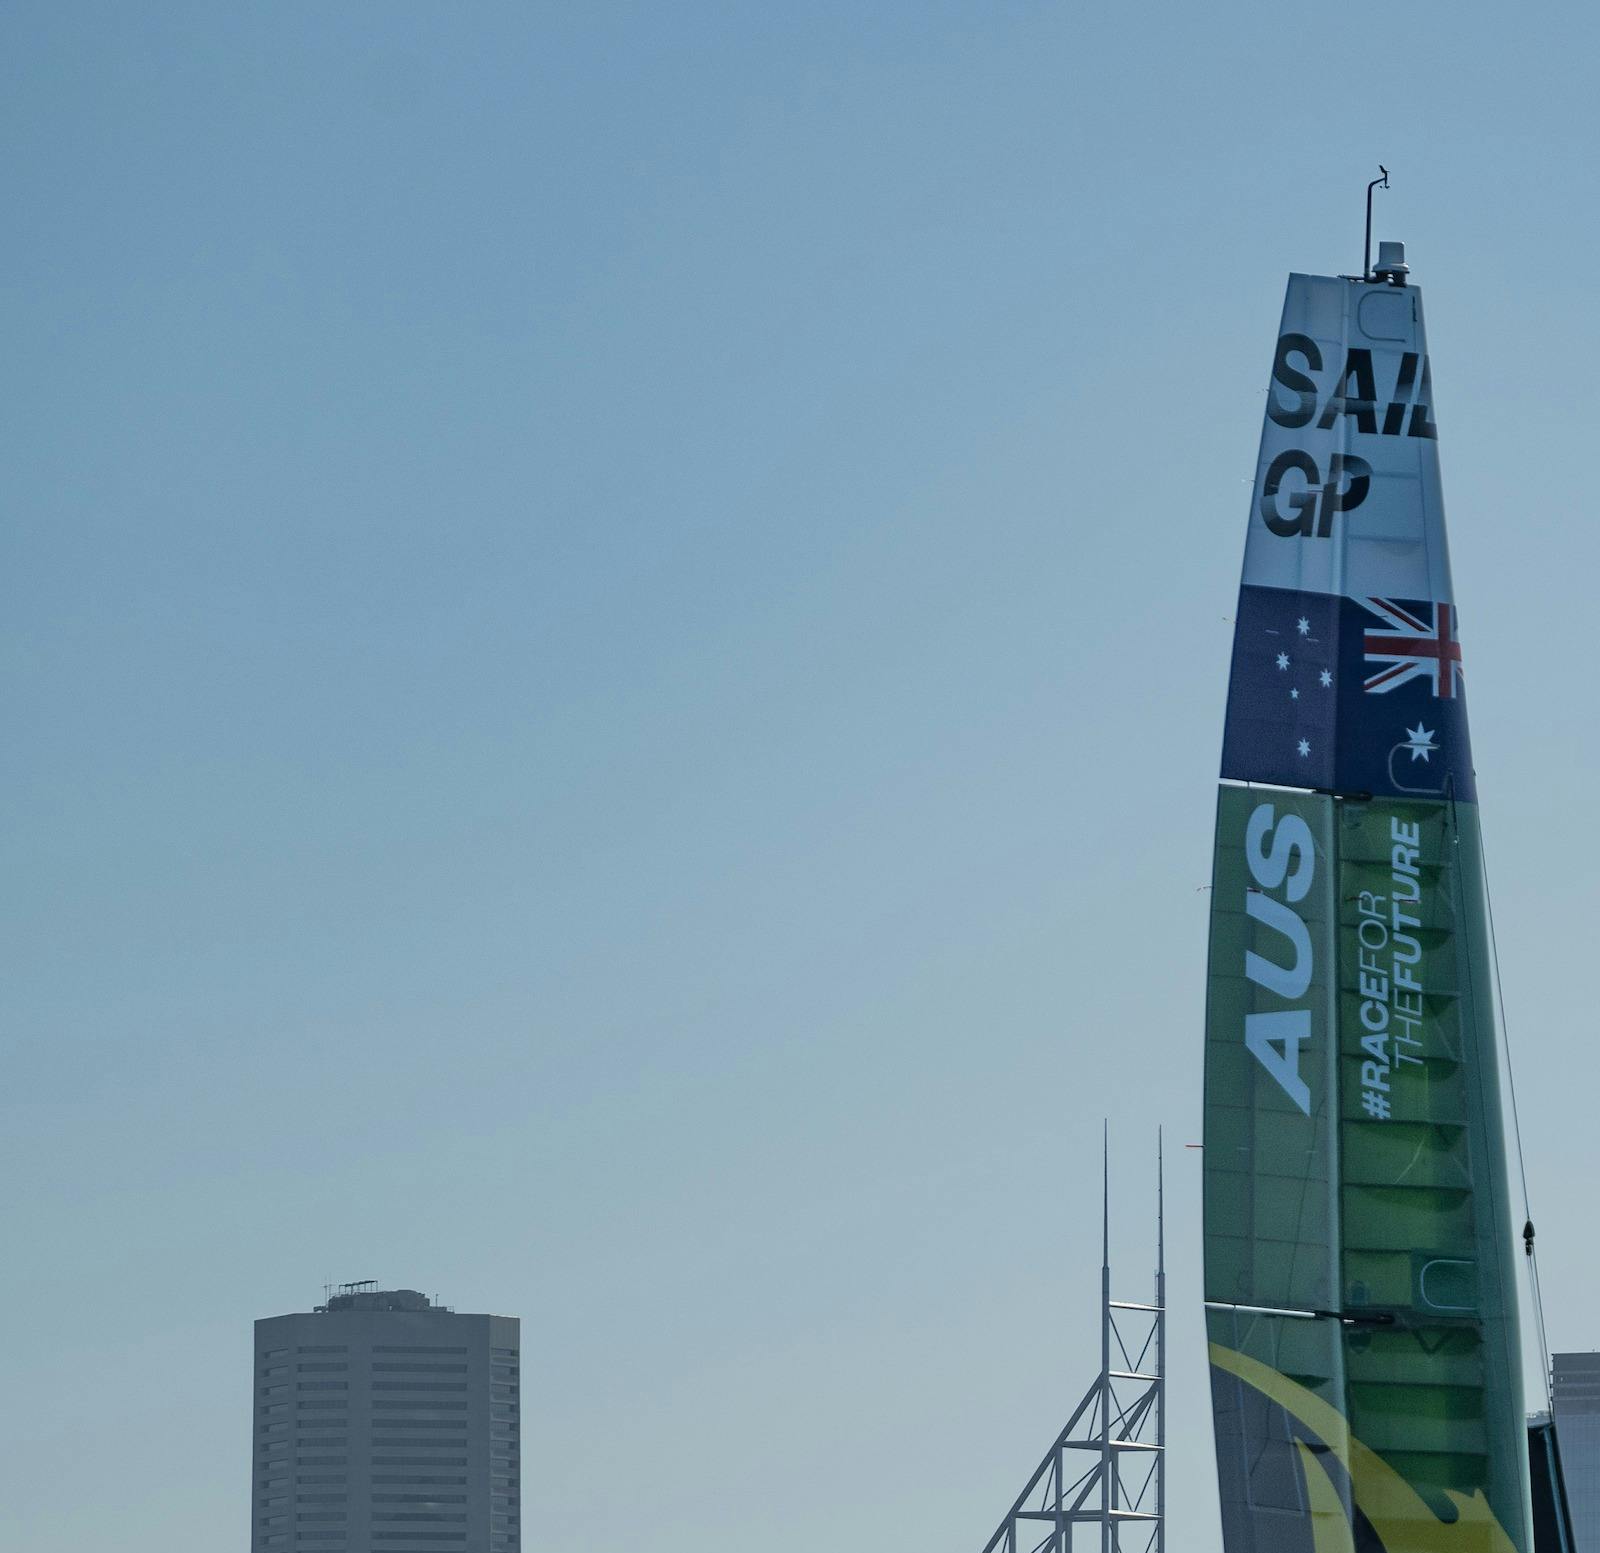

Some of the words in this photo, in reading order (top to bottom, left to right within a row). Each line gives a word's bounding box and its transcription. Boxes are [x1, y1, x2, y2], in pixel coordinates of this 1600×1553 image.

[1265, 332, 1439, 440] SAIL
[1260, 449, 1373, 538] GP
[1245, 803, 1316, 1117] AUS
